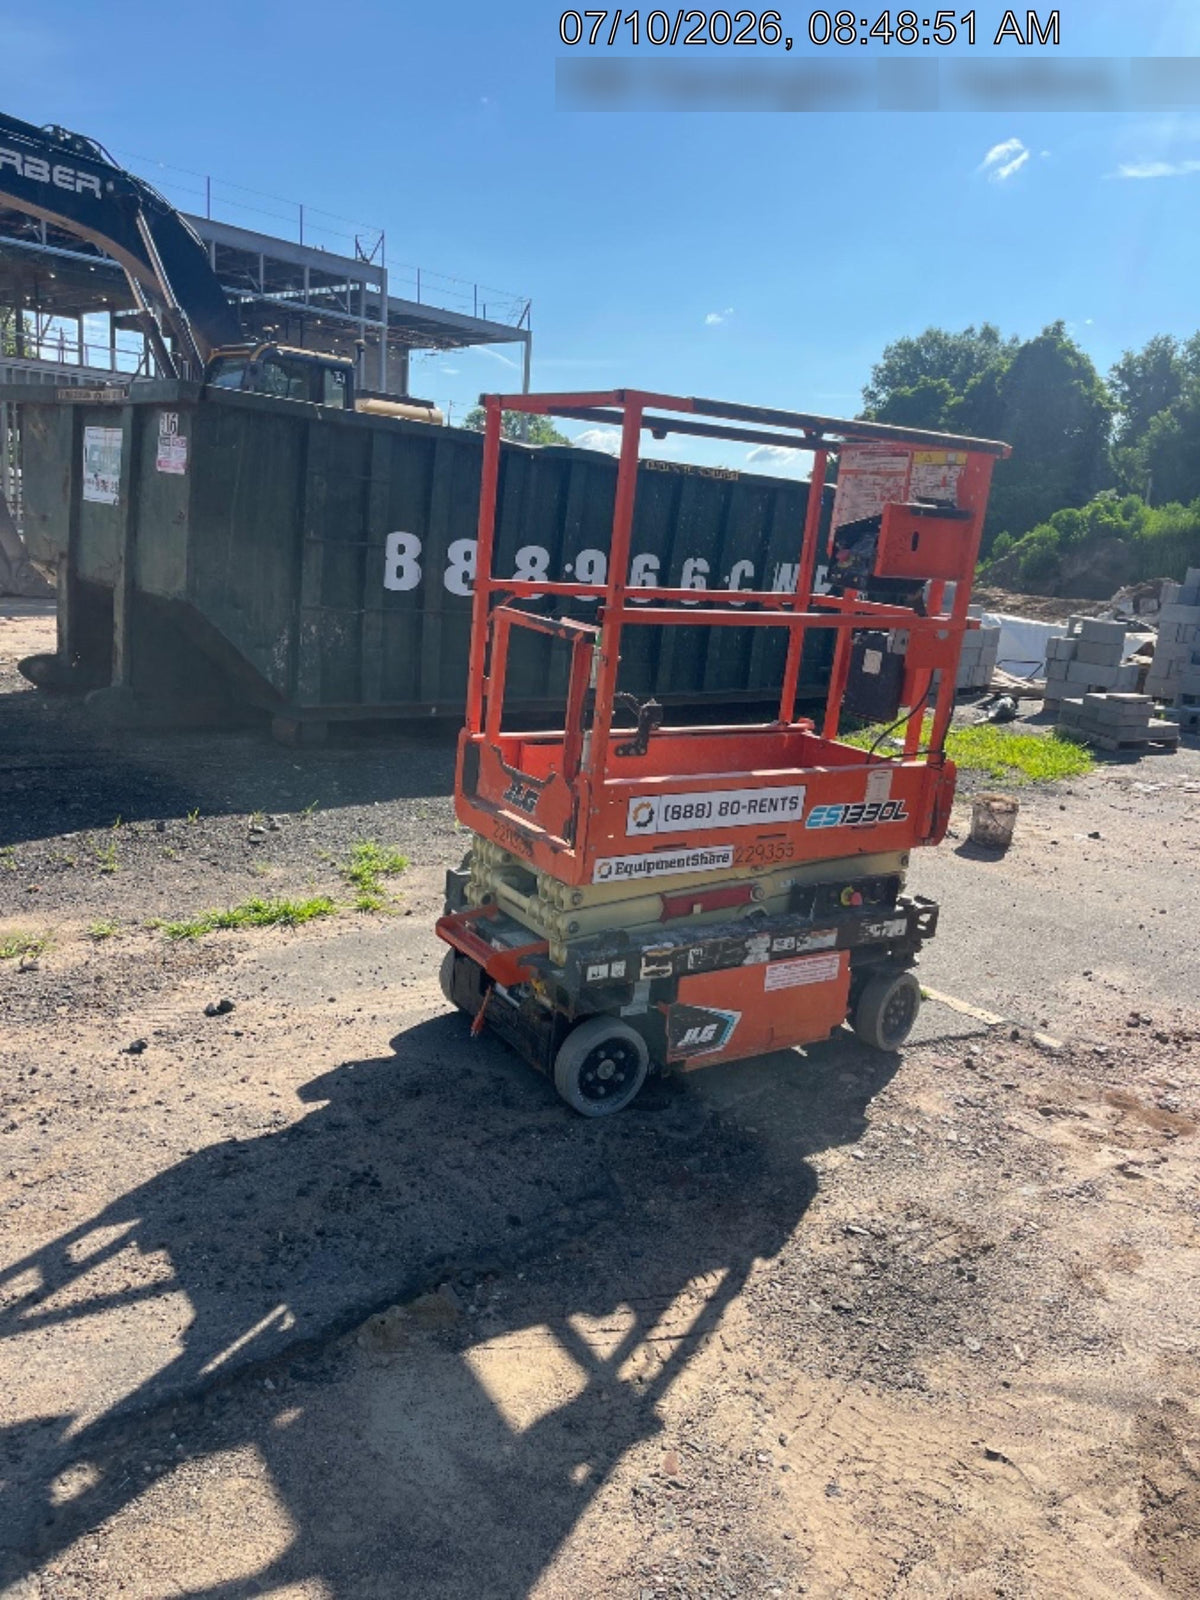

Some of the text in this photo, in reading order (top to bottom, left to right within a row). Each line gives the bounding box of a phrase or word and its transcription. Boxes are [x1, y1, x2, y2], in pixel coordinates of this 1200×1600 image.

[664, 796, 799, 822] (888) 80-RENTS
[805, 800, 909, 828] ES1330L
[615, 852, 730, 876] EquipmentShare
[735, 842, 795, 864] 229355
[677, 1023, 719, 1047] JLG
